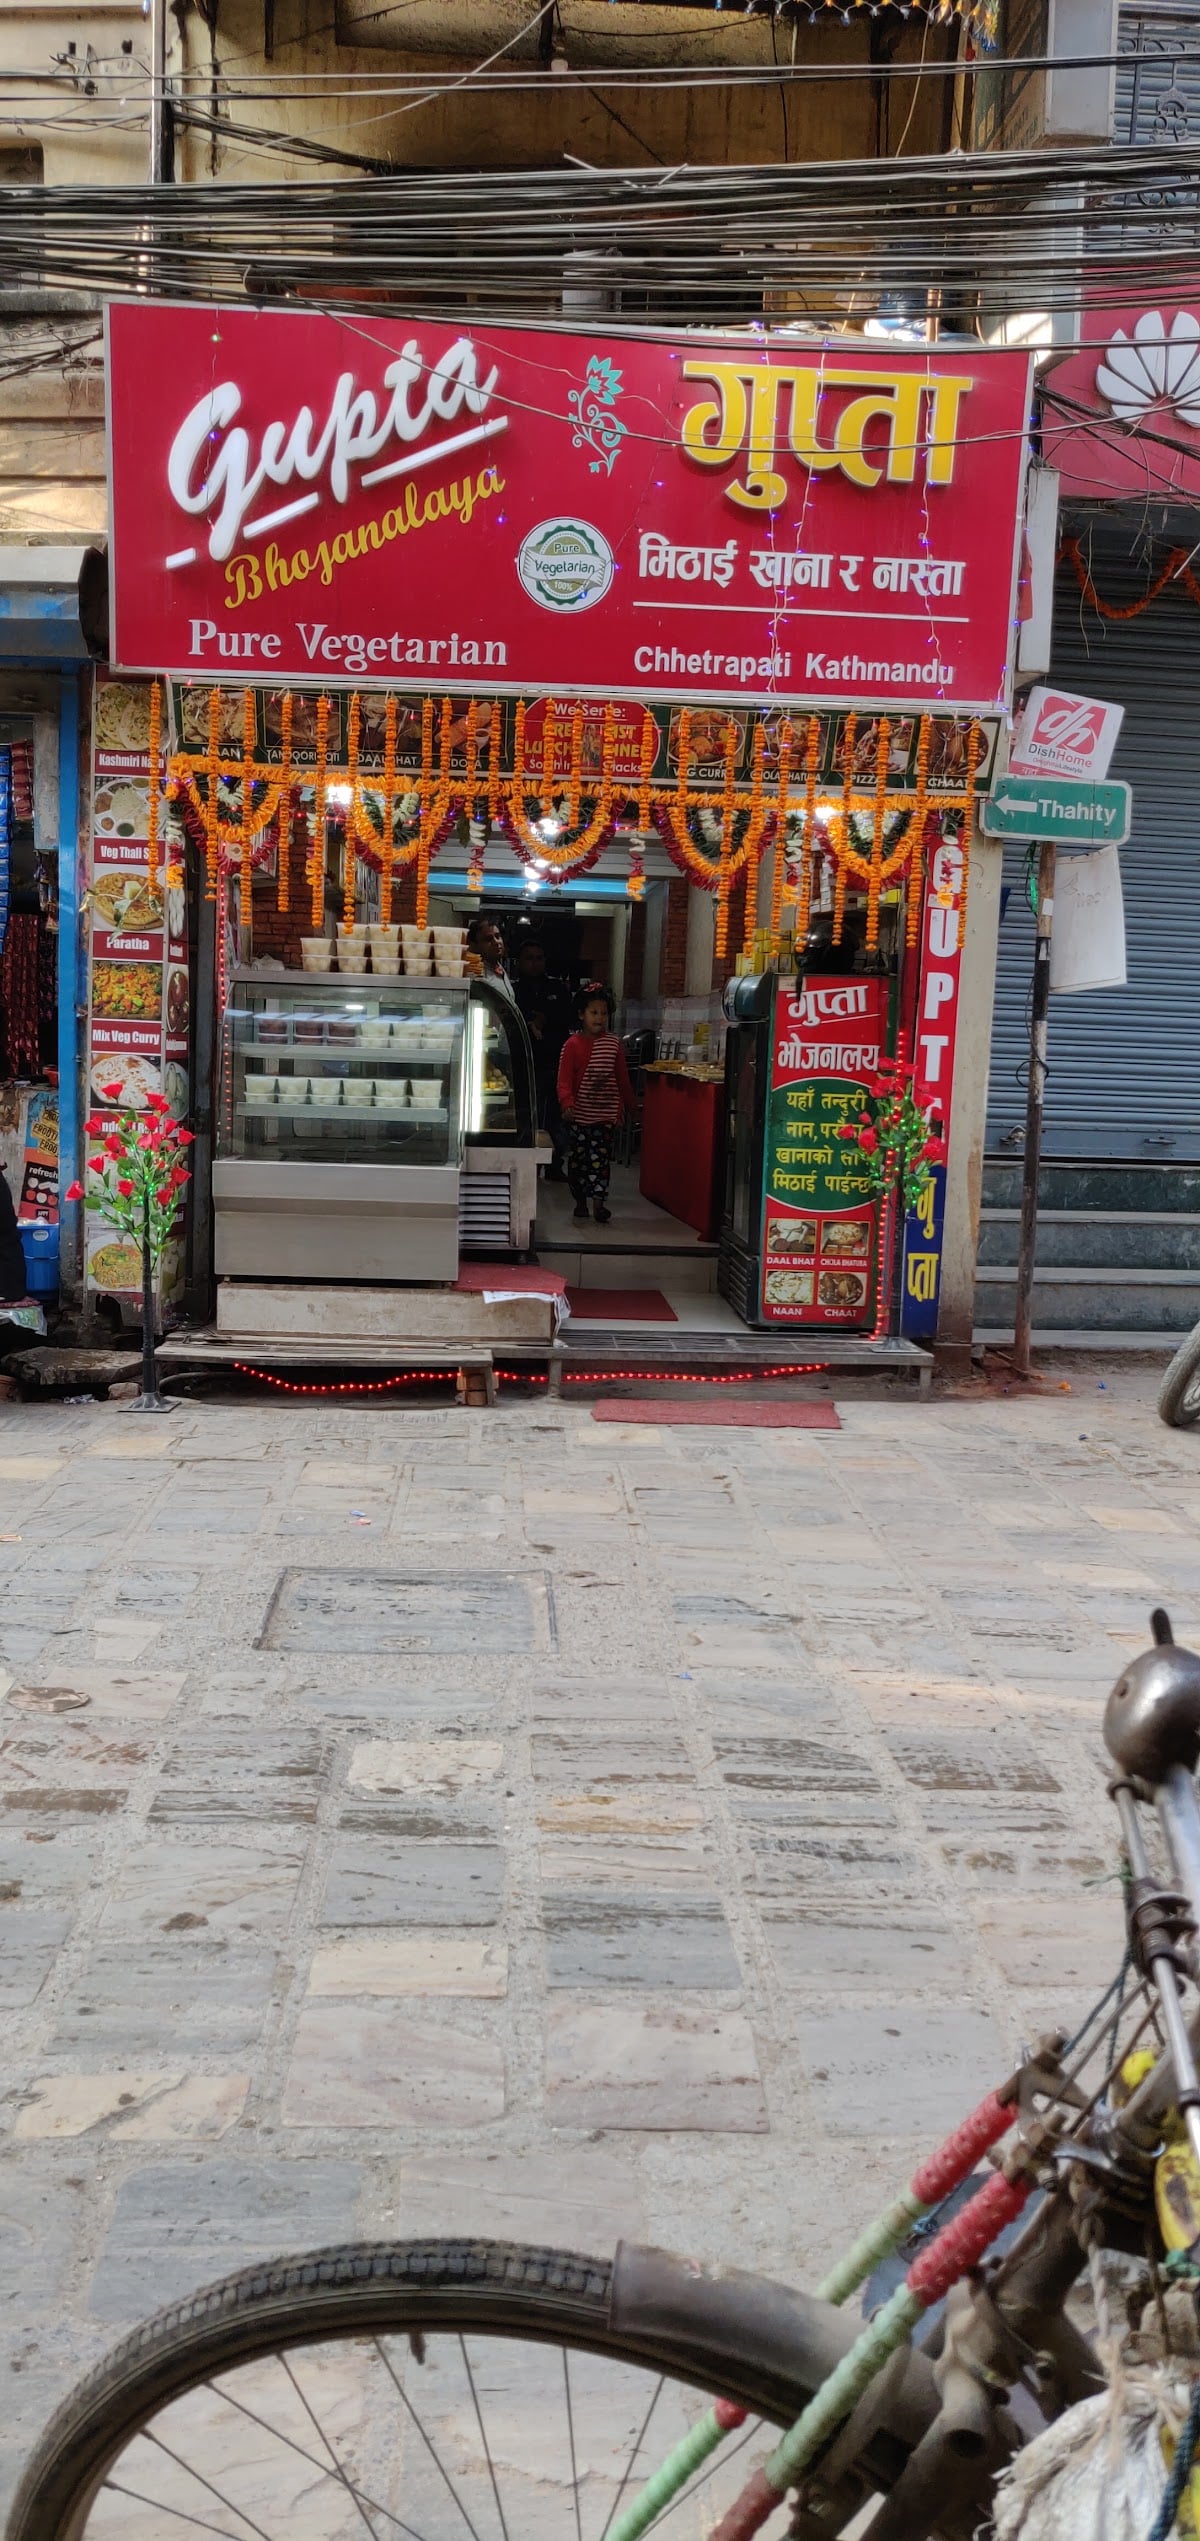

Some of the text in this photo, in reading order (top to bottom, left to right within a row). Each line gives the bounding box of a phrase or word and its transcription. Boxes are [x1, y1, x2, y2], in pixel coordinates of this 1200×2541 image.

[681, 361, 973, 510] गुप्ता
[167, 339, 500, 561] Gupta
[223, 465, 506, 609] Bhojanalaya
[554, 543, 579, 553] Pure
[534, 560, 596, 577] Vegetarian
[639, 532, 967, 597] मिठाई खाना र नास्ता
[554, 581, 573, 592] 100%
[188, 619, 507, 672] Pure Vegetarian
[634, 646, 955, 686] Chhetrapati Kathmandu
[554, 703, 627, 718] We Sere:
[99, 753, 165, 769] Kashmiri Nan
[389, 755, 417, 766] HAT
[451, 758, 482, 768] DOA
[1028, 743, 1093, 768] DishHome
[672, 767, 696, 777] VG
[1039, 798, 1116, 826] Thahity
[101, 845, 118, 859] Veg
[119, 846, 142, 859] Thali
[107, 937, 150, 950] Paratha
[786, 985, 869, 1027] गुप्ता
[92, 1029, 110, 1042] Mix
[111, 1030, 130, 1043] Veg
[132, 1031, 160, 1045] Curry
[778, 1034, 879, 1072] भोजनालय
[786, 1086, 815, 1111] यहाँ
[776, 1145, 833, 1165] खानाको
[772, 1168, 817, 1193] मिठाई
[766, 1256, 816, 1266] DAAL BHAT
[772, 1307, 803, 1316] NAAN
[824, 1308, 857, 1317] CHAAT
